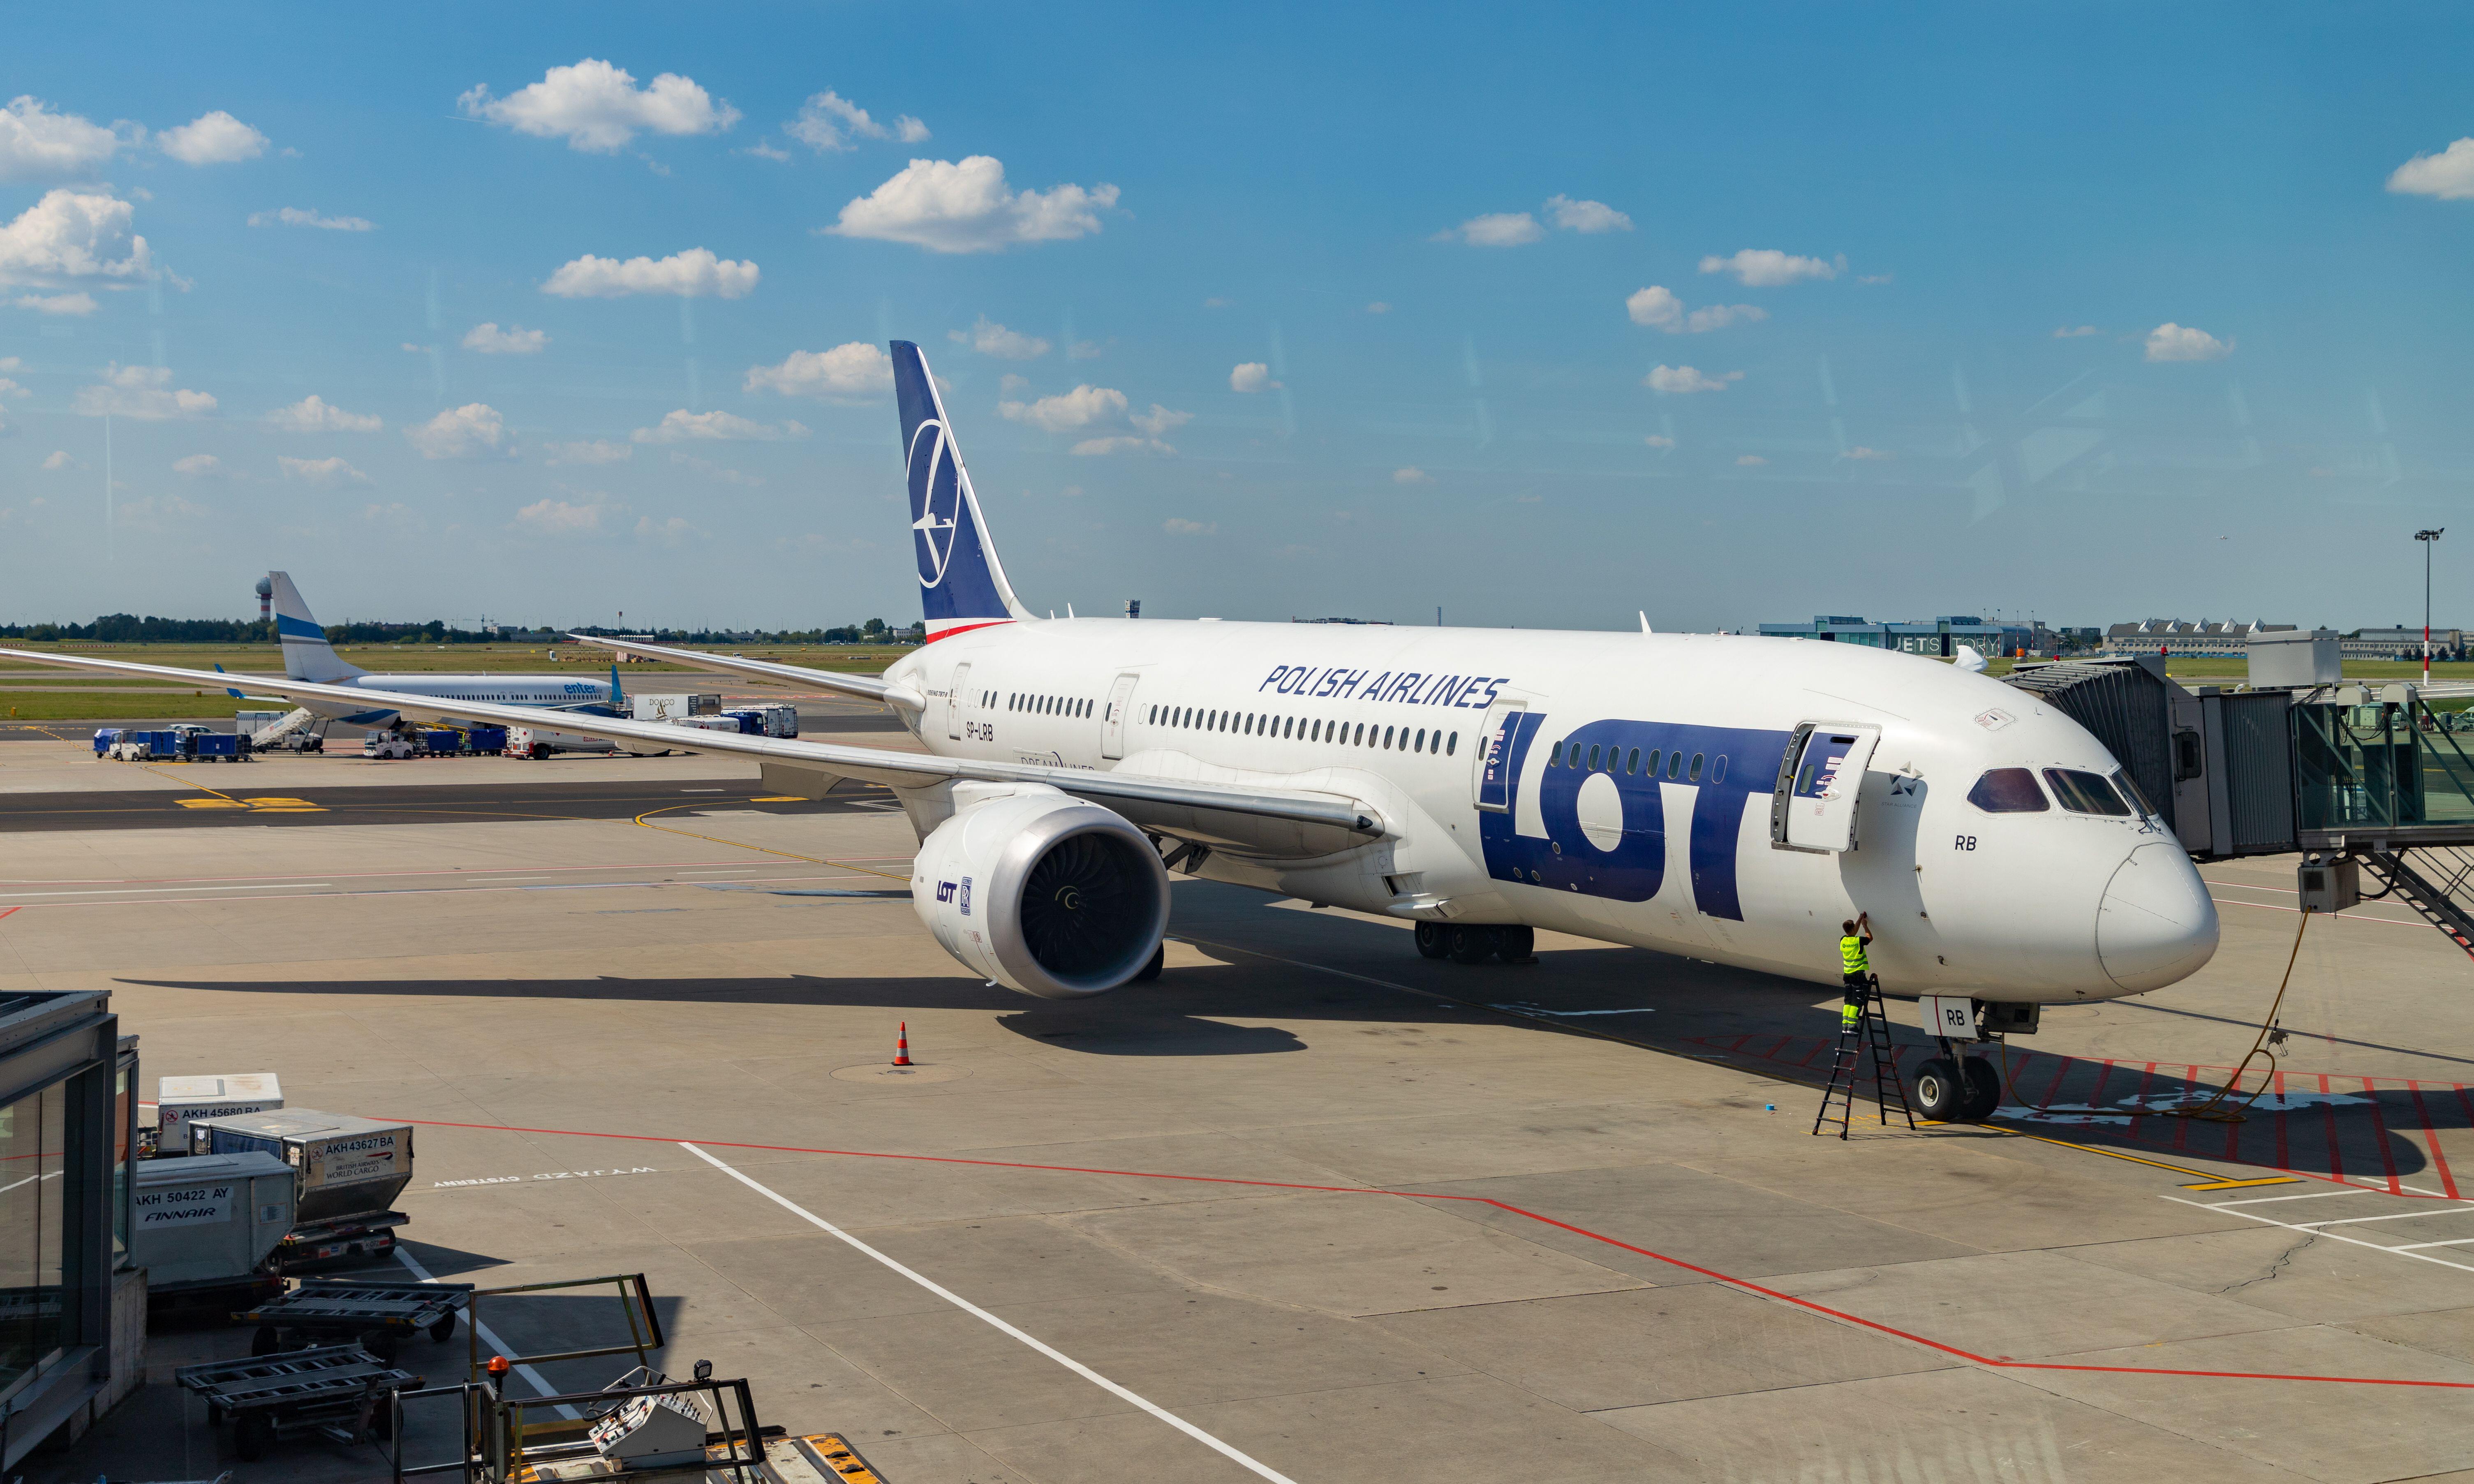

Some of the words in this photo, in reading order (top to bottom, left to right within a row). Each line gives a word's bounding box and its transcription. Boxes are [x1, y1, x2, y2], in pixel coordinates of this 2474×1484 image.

[564, 682, 596, 694] enter
[1258, 665, 1369, 698] POLISH
[1359, 671, 1510, 709] AIRLINES
[966, 721, 993, 742] SP-LRB
[1479, 711, 1858, 921] LOT
[1955, 835, 1977, 851] RB
[936, 880, 957, 904] LOT
[1946, 1009, 1965, 1026] RB
[183, 1109, 207, 1118] AKH
[210, 1108, 242, 1117] 45680
[326, 1143, 348, 1155] AKH
[349, 1139, 378, 1151] 43627
[380, 1136, 394, 1147] BA
[327, 1170, 353, 1179] WORLD
[354, 1165, 379, 1175] CARGO
[534, 1167, 657, 1179] WYJAZD
[434, 1176, 520, 1187] CYSTERNY
[167, 1190, 205, 1203] 50422
[213, 1188, 229, 1198] AY
[145, 1207, 216, 1222] FINNAIR
